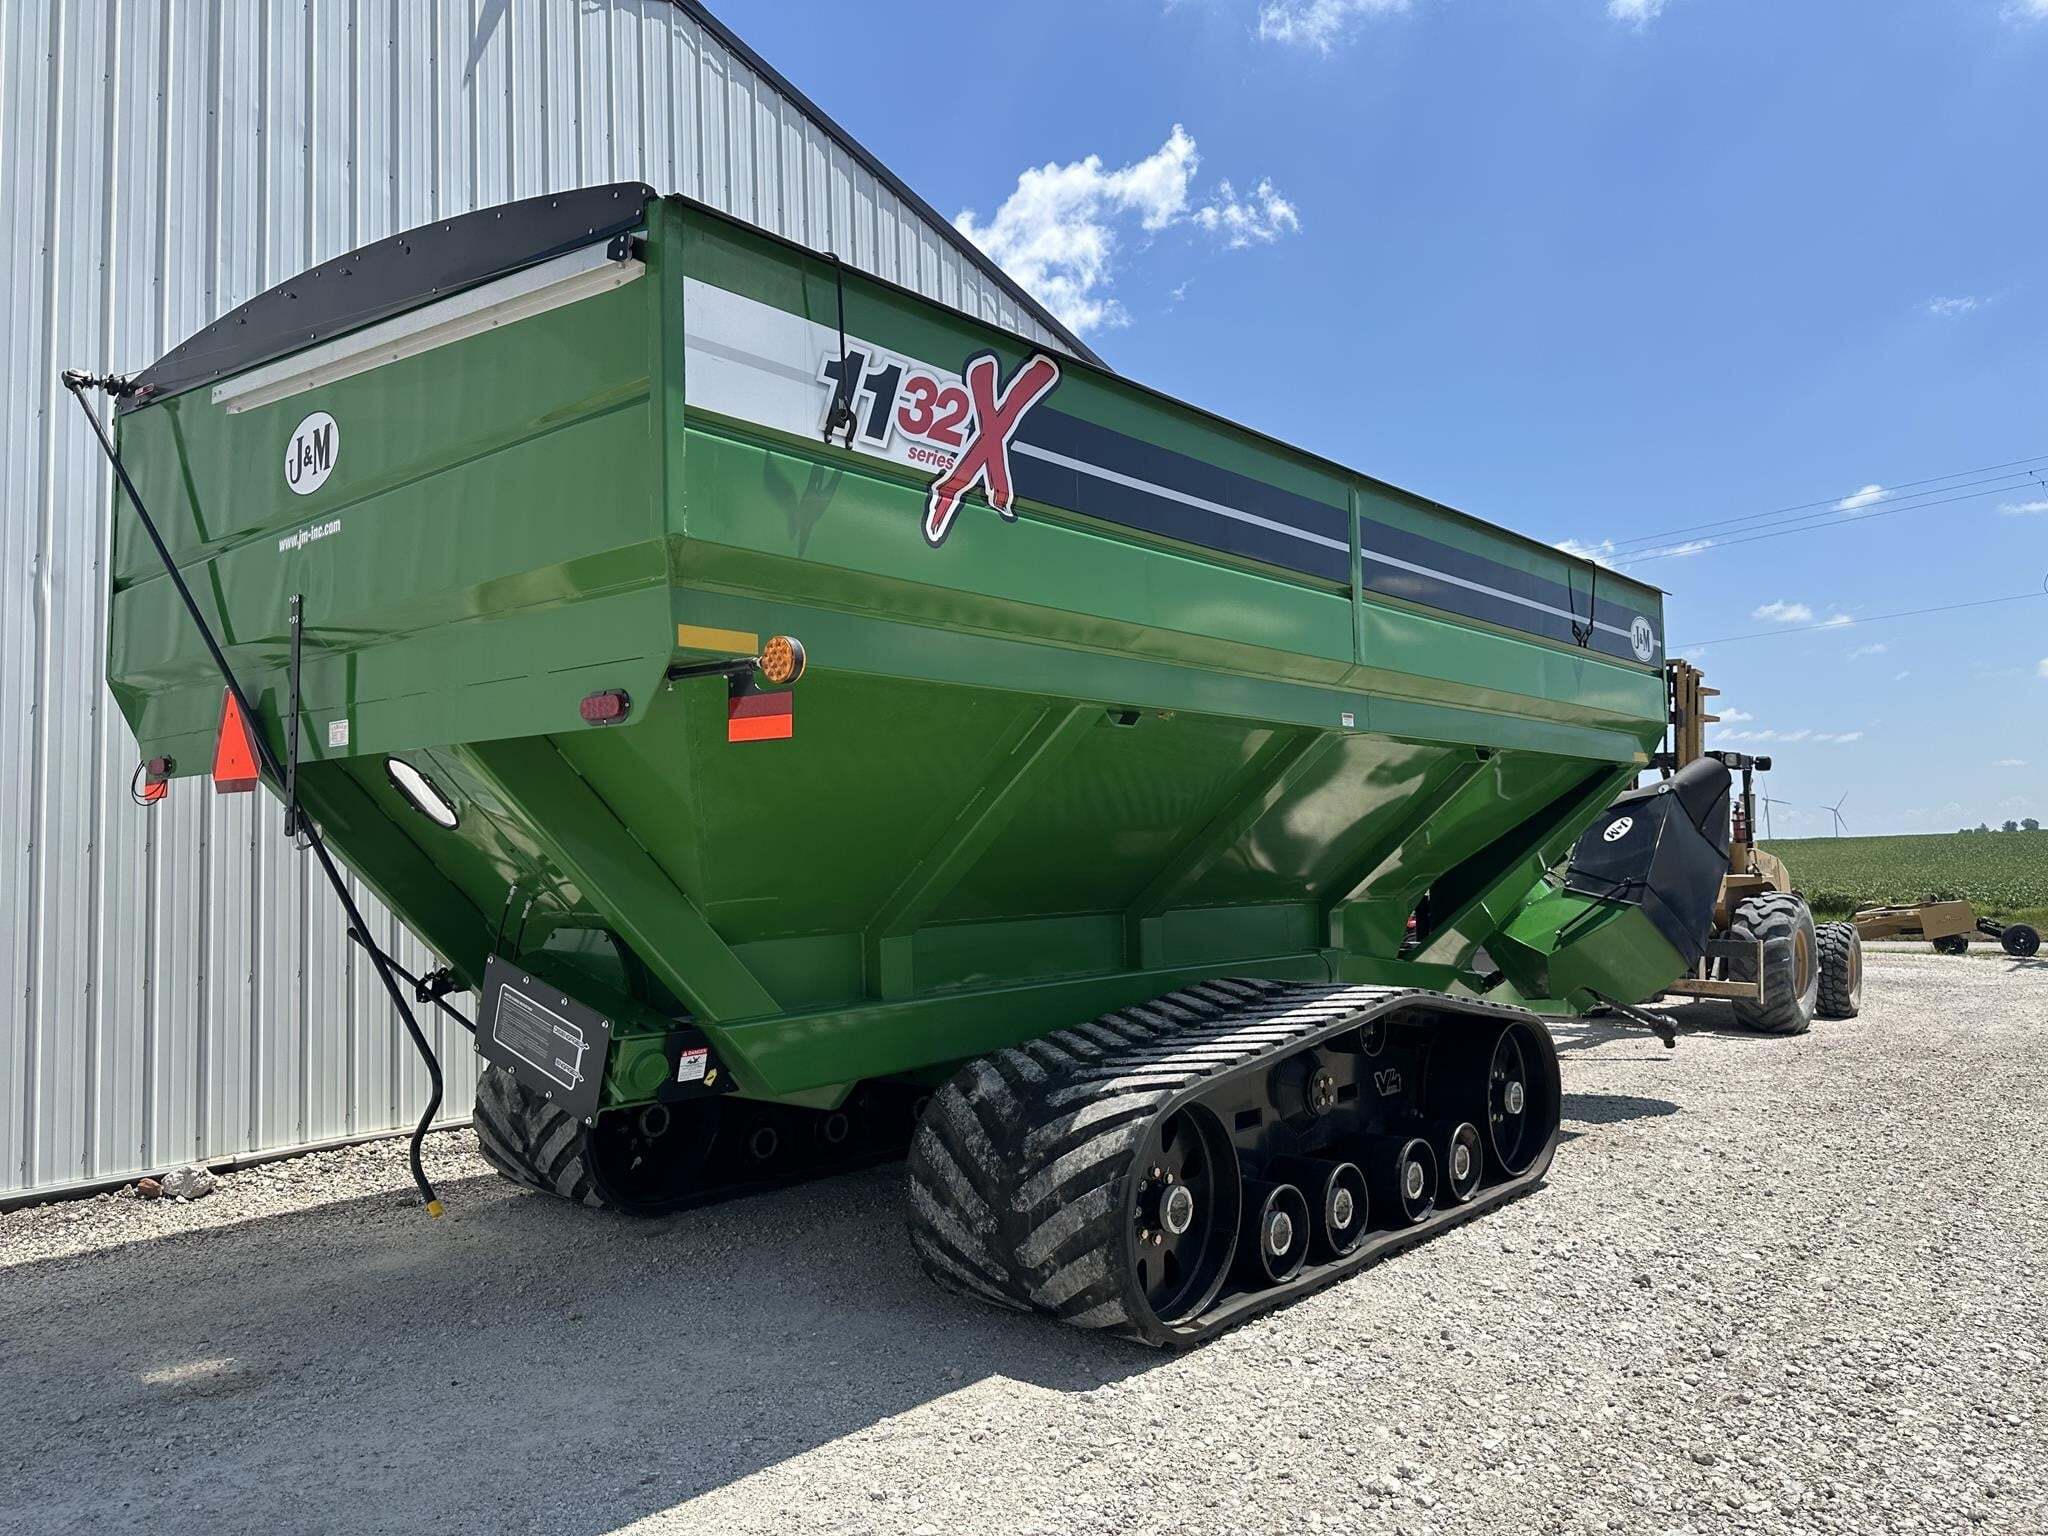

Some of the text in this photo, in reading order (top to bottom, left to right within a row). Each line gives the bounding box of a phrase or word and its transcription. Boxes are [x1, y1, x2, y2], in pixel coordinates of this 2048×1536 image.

[288, 422, 332, 484] J&M
[907, 445, 955, 471] series
[279, 519, 341, 552] www.jm-inc.com
[1633, 625, 1651, 653] J&M
[1606, 817, 1631, 839] J&M
